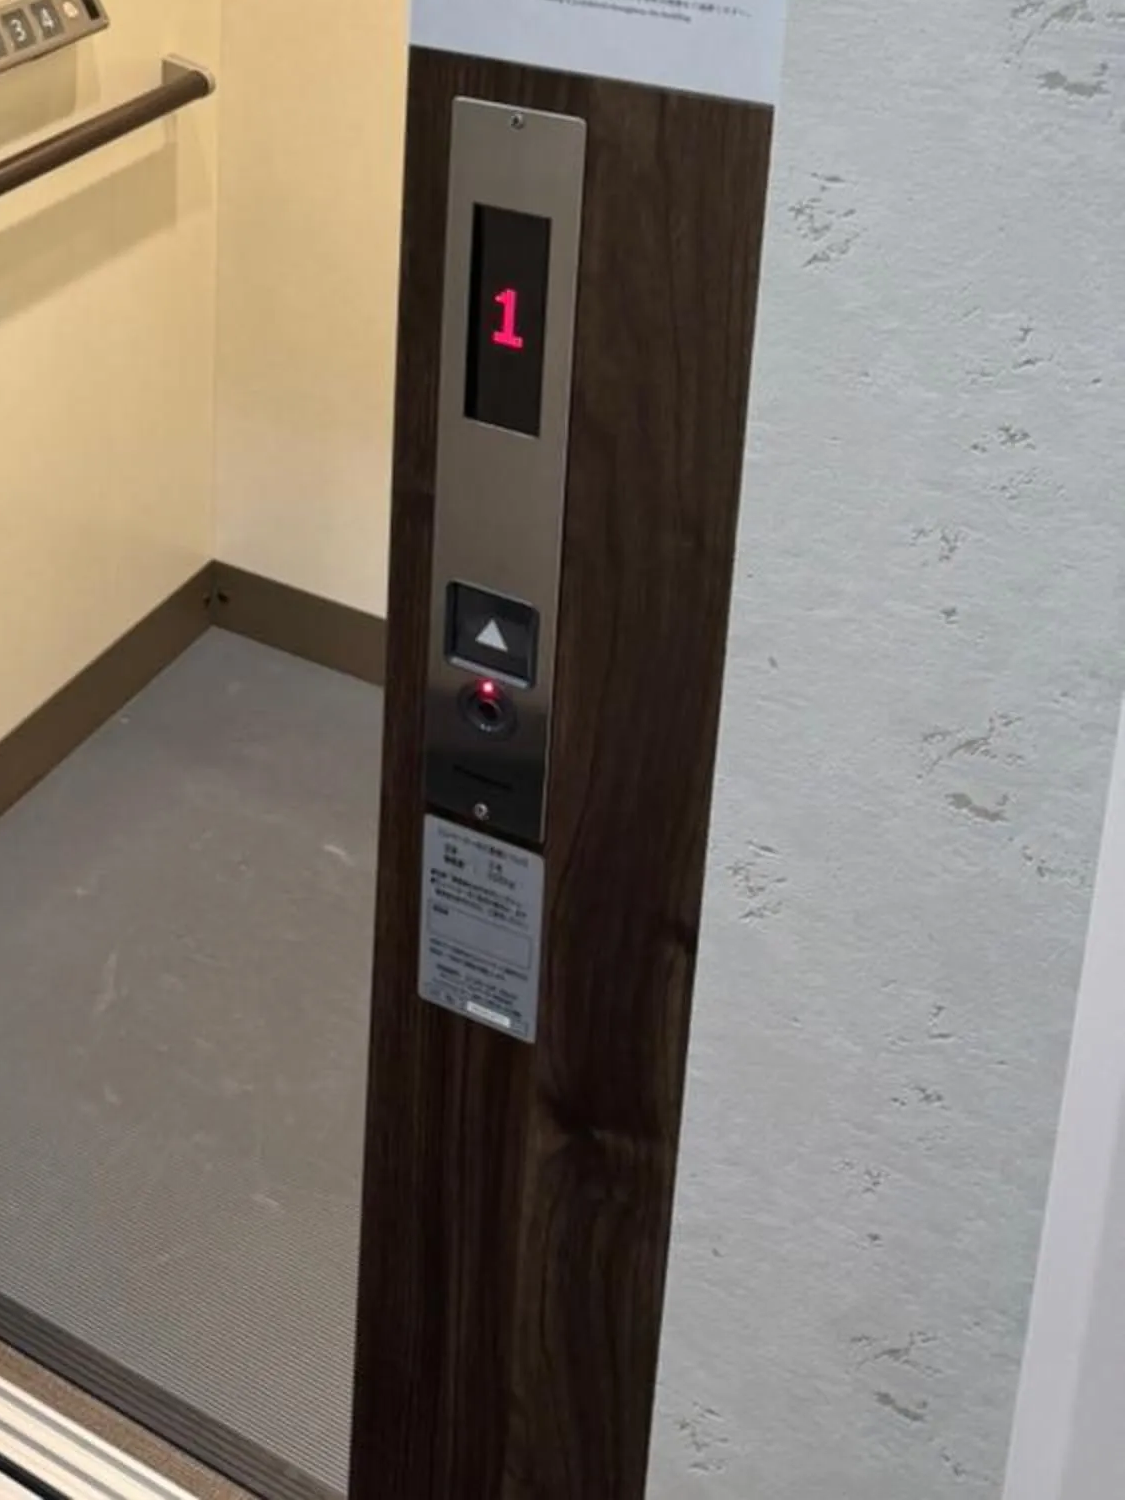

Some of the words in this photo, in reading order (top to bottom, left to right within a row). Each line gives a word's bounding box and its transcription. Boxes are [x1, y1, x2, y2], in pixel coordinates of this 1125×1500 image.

[10, 18, 27, 42] 3
[40, 6, 55, 31] 4
[492, 288, 524, 349] 1
